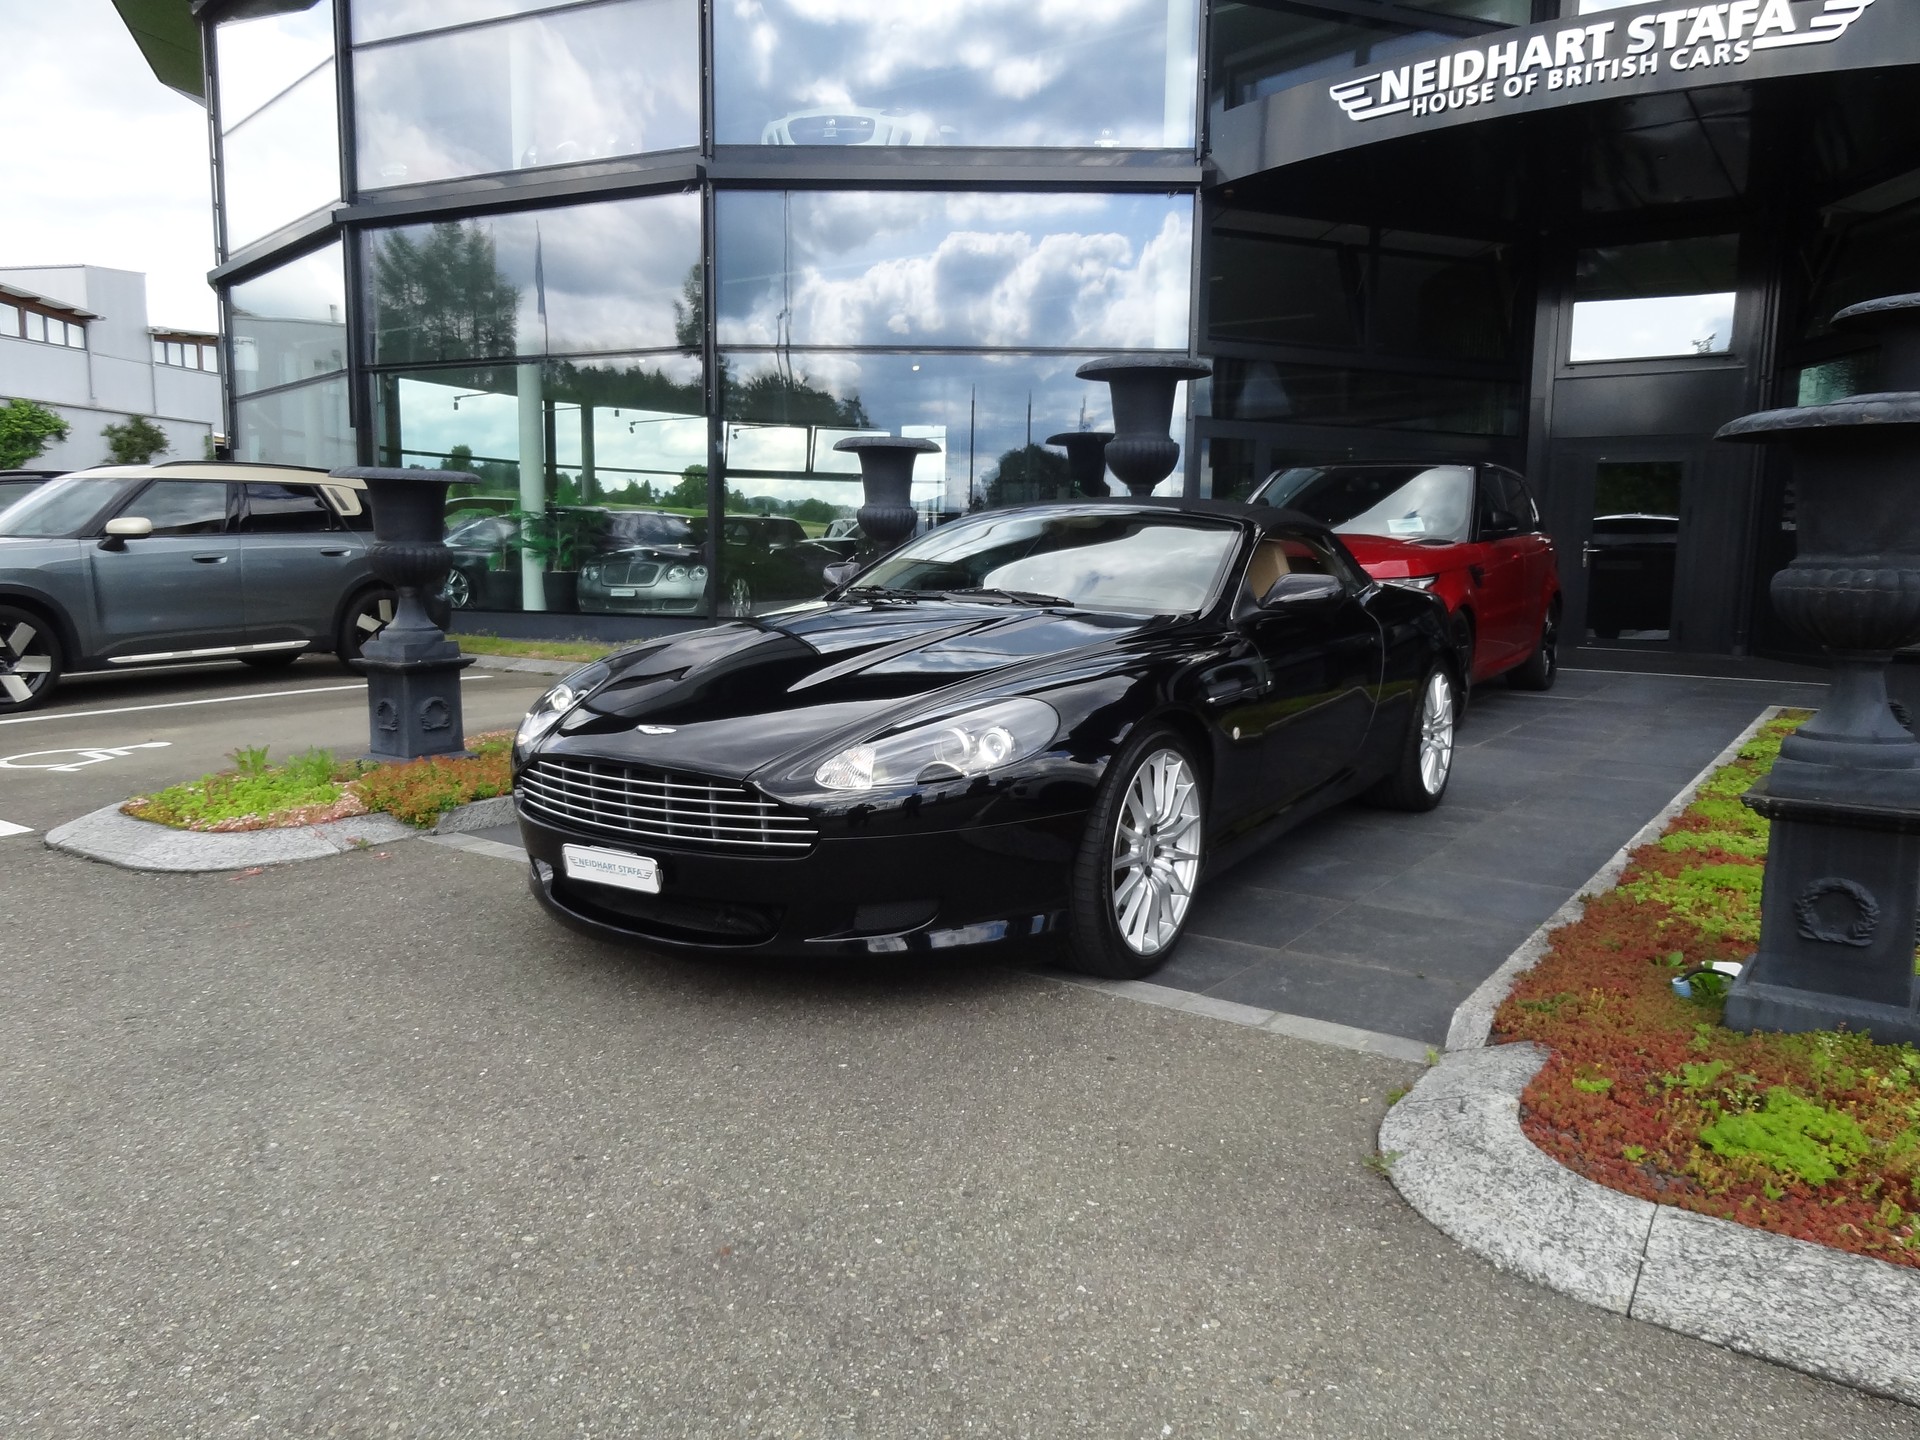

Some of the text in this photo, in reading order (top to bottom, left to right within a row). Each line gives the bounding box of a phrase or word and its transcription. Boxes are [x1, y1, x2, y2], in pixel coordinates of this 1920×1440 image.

[1380, 21, 1614, 104] NEIDHART
[1412, 40, 1750, 117] HOUSE OF BRITISH CARS
[579, 858, 616, 871] NEIDHART
